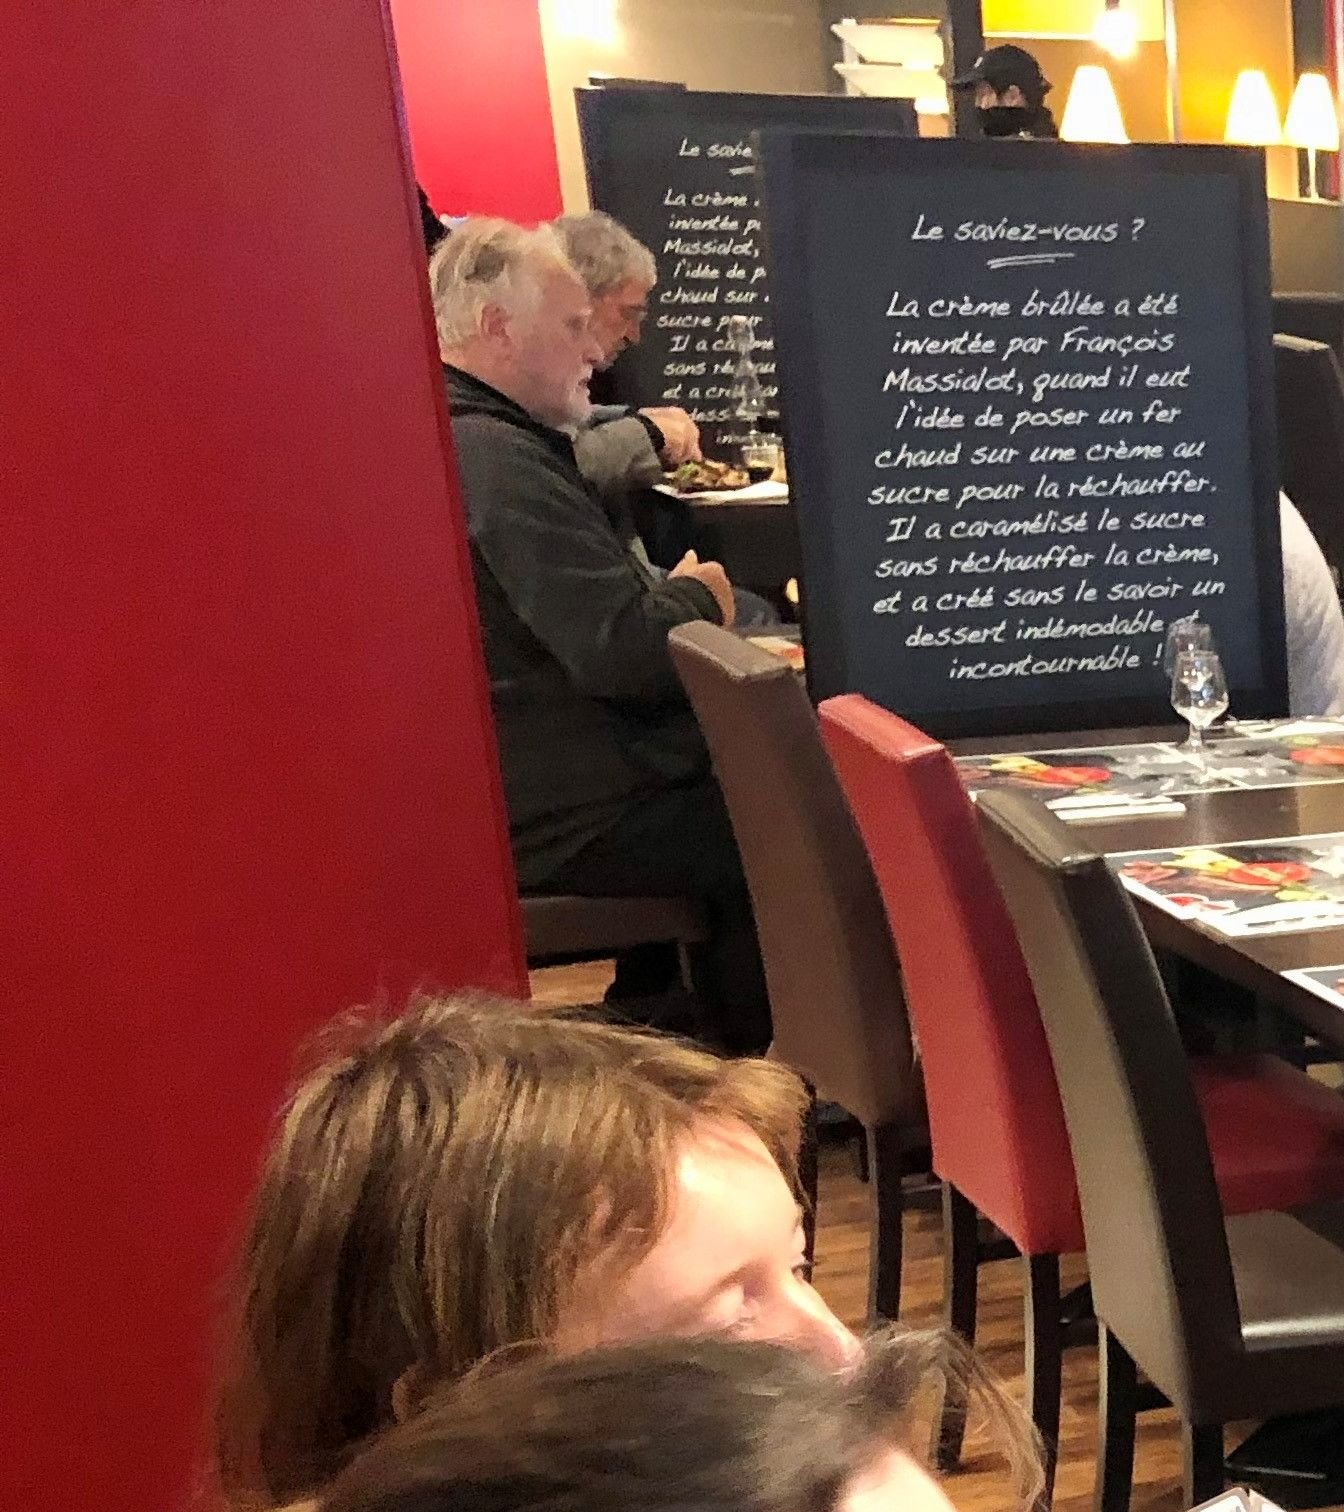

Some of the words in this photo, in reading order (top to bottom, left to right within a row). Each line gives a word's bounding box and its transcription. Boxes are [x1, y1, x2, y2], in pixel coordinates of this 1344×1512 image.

[678, 137, 700, 157] Le
[706, 141, 754, 158] savie
[663, 188, 686, 207] La
[911, 214, 944, 240] Le
[954, 217, 1119, 242] saviez-vous
[1132, 217, 1145, 241] ?
[725, 262, 746, 280] de
[660, 286, 719, 304] chaud
[724, 290, 758, 304] sur
[886, 291, 920, 318] La
[928, 295, 1011, 318] crème
[1021, 288, 1105, 317] brûlée
[1114, 299, 1130, 317] a
[1137, 292, 1179, 316] été
[656, 314, 713, 328] sucre
[695, 339, 708, 352] a
[892, 330, 996, 355] inventée
[1001, 337, 1048, 361] par
[1059, 325, 1175, 358] François
[663, 361, 706, 376] sans
[882, 366, 1024, 395] Massialot,
[1032, 365, 1112, 403] quand
[1119, 364, 1139, 388] il
[1145, 364, 1191, 387] eut
[688, 387, 701, 399] a
[895, 399, 965, 430] l'idée
[974, 404, 1004, 427] de
[1010, 408, 1089, 435] poser
[1098, 408, 1134, 424] un
[1142, 399, 1181, 424] fer
[874, 441, 962, 469] chaud
[970, 446, 1020, 465] sur
[1029, 446, 1077, 463] une
[1085, 439, 1164, 461] crème
[1173, 441, 1206, 459] au
[867, 485, 950, 505] sucre
[955, 484, 1025, 510] pour
[1034, 474, 1060, 499] la
[1067, 469, 1217, 497] réchauffer.
[886, 515, 917, 542] Il
[924, 522, 942, 540] a
[950, 509, 1088, 539] caramélisé
[1097, 507, 1120, 531] le
[1130, 512, 1205, 530] sucre
[874, 556, 939, 578] sans
[948, 544, 1096, 574] réchauffer
[1104, 541, 1130, 566] la
[1136, 543, 1219, 565] crème,
[873, 590, 902, 614] et
[911, 595, 928, 612] a
[936, 585, 995, 611] créé
[1003, 585, 1066, 607] sans
[1074, 579, 1098, 602] le
[1106, 579, 1184, 601] savoir
[1191, 580, 1226, 596] un
[905, 619, 1007, 647] dessert
[1016, 608, 1164, 640] indémodable
[949, 644, 1141, 679] incontournable
[1152, 643, 1163, 666] !
